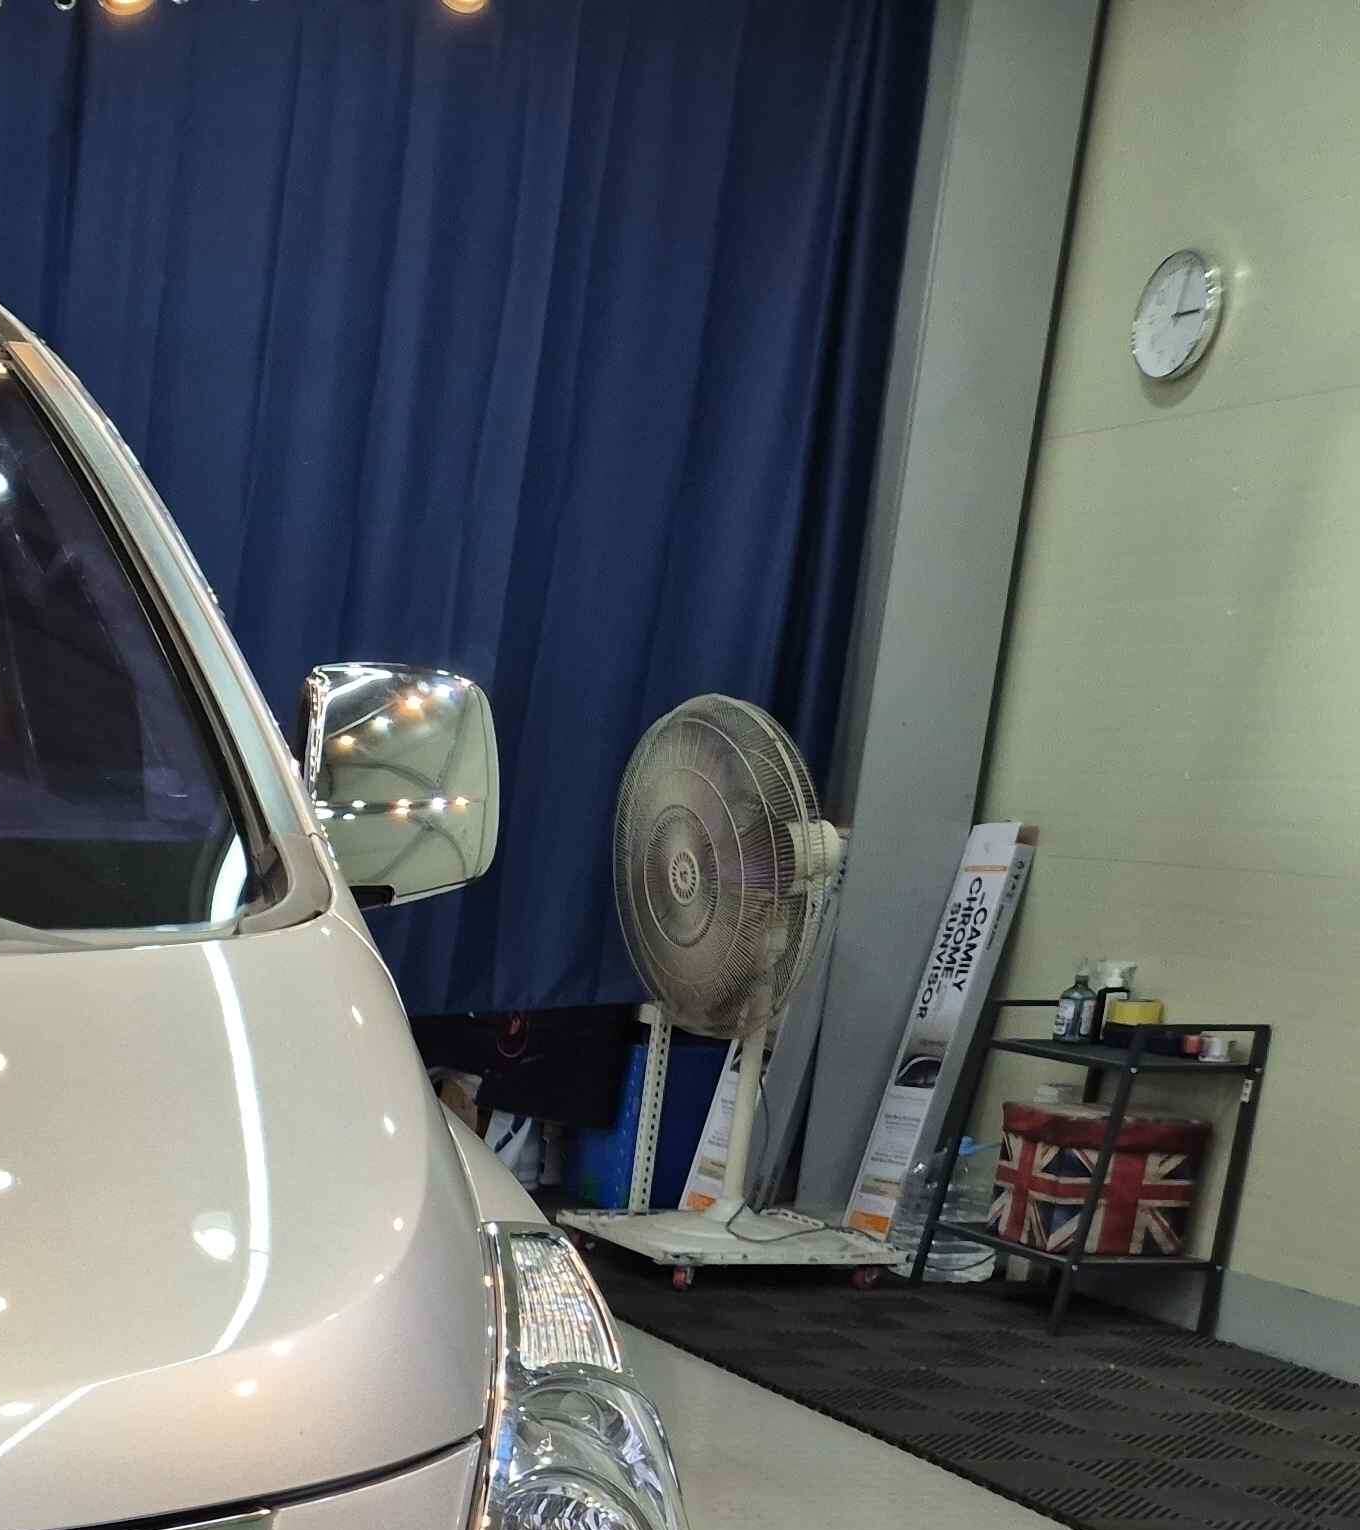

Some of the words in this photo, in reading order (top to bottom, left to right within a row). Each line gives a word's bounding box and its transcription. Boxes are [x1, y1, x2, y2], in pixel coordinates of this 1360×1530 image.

[916, 902, 962, 1020] SUNVISOR
[942, 876, 983, 980] CHROME
[951, 906, 988, 992] CAMILY
